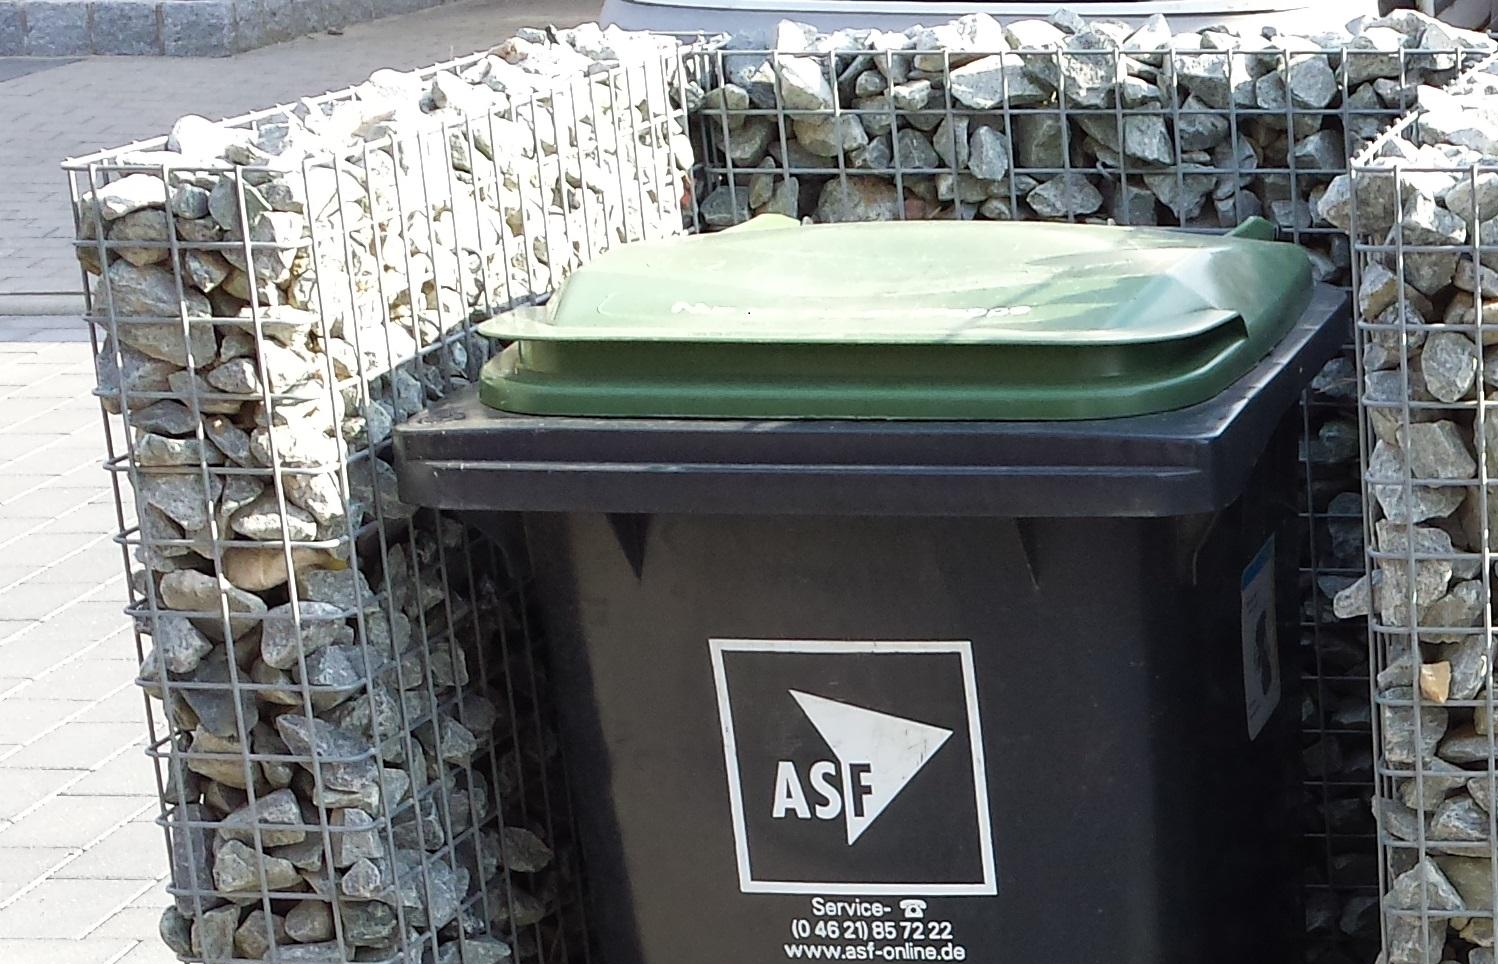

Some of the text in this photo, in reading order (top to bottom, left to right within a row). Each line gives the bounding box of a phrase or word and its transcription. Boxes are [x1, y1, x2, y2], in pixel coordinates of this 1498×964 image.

[772, 760, 873, 820] ASF
[811, 896, 892, 917] Service-
[791, 919, 954, 941] (0 46 21) 85 72 22
[784, 941, 966, 961] www.asf-online.de
